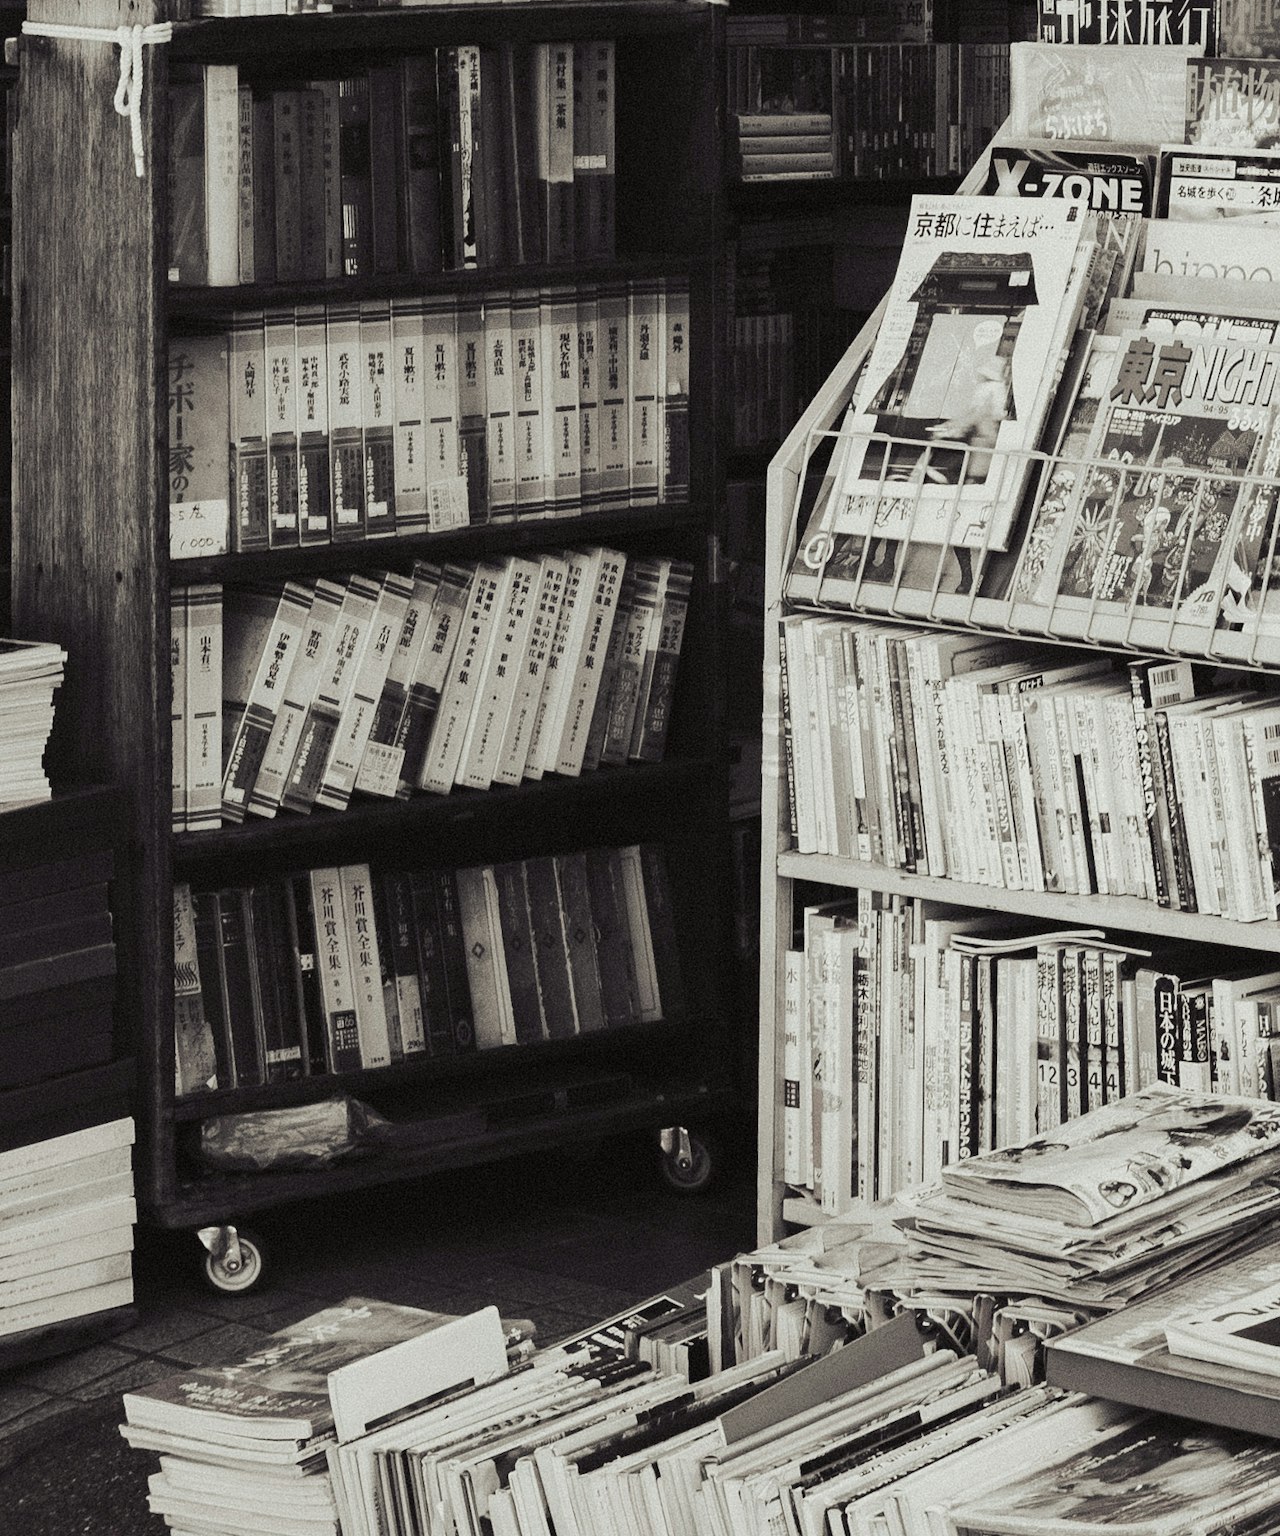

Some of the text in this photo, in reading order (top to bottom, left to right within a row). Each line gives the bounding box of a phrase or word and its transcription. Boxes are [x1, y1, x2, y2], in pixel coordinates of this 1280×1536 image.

[993, 159, 1143, 211] X-ZONE
[1178, 185, 1225, 200] 名城を歩く
[404, 346, 415, 384] 夏目漱石
[435, 344, 445, 381] 夏目漱石
[560, 333, 571, 379] 現代名作集
[200, 635, 211, 673] 山本有三
[321, 887, 342, 971] 芥川賞全集
[352, 884, 373, 967] 芥川賞全集
[1039, 1065, 1045, 1082] 1
[1048, 1066, 1058, 1085] 2
[1067, 1068, 1077, 1086] 3
[1089, 1071, 1100, 1090] 4
[1106, 1072, 1117, 1091] 4
